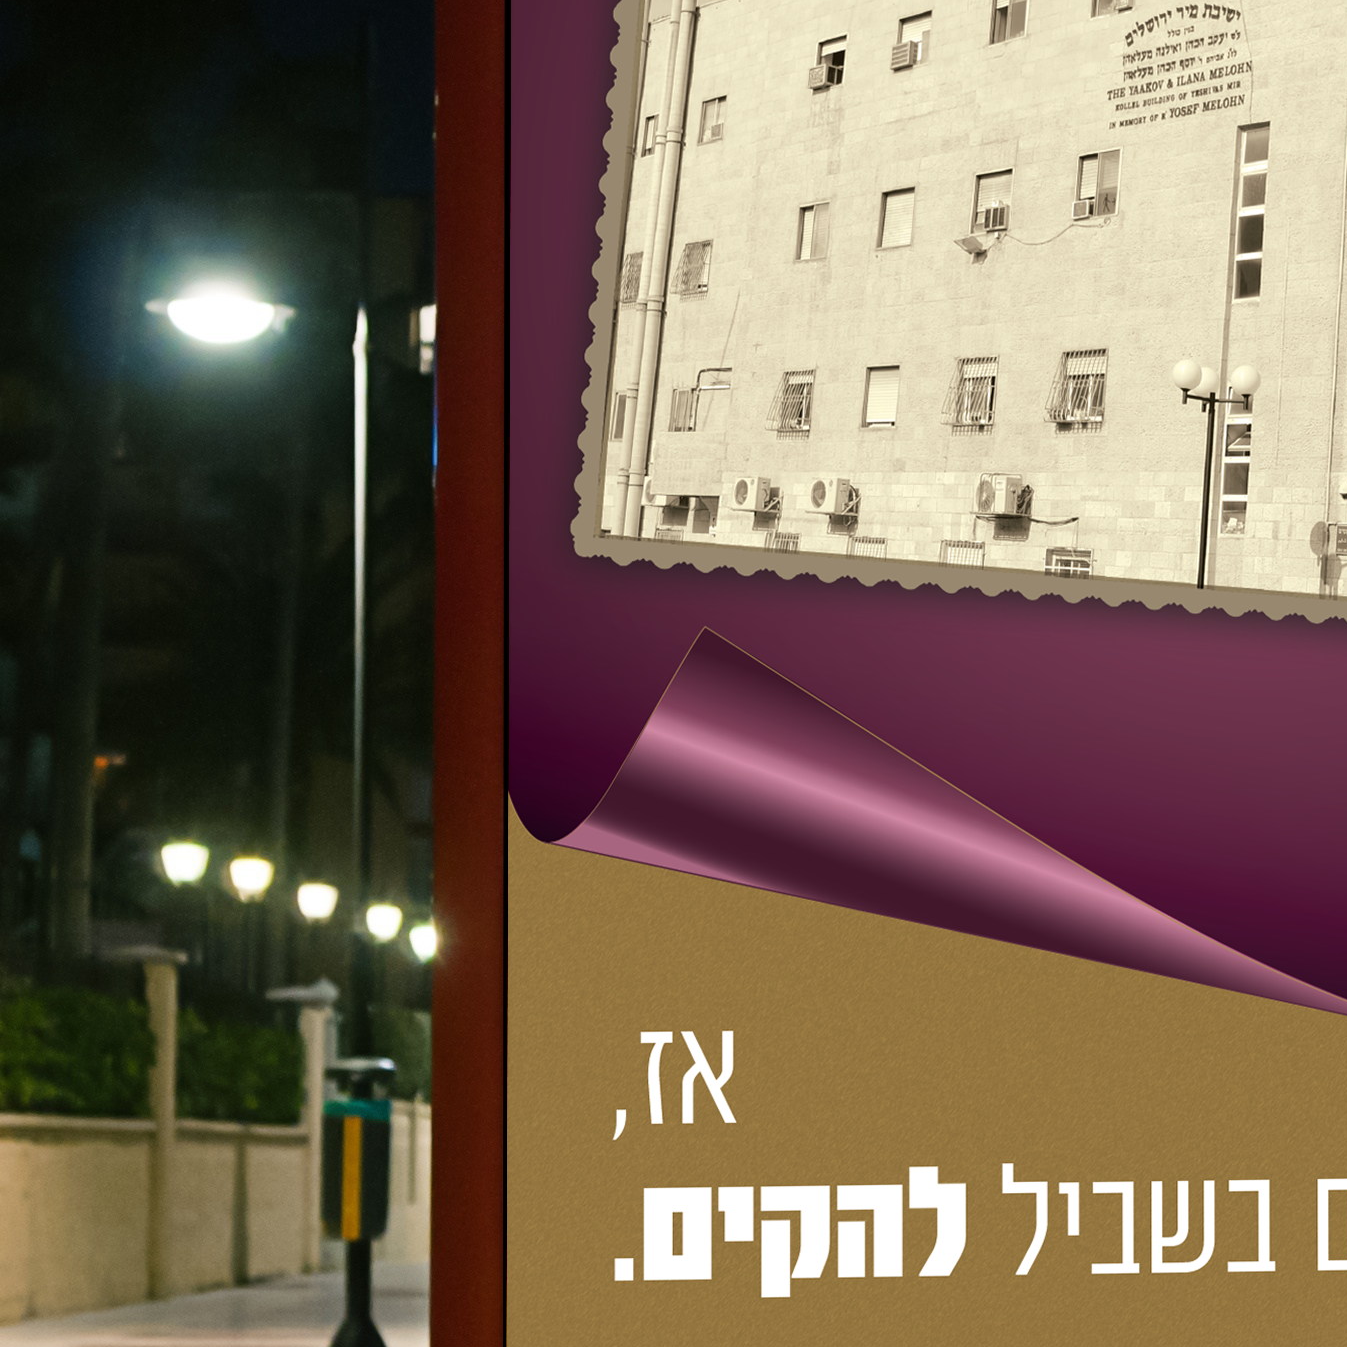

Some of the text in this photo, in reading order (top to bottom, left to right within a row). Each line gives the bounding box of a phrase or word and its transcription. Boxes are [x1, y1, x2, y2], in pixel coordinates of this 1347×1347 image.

[1125, 3, 1241, 47] ישיבת מיר ירושלים
[1107, 60, 1253, 101] THE YAAKOV & ILANA MELOHN
[1115, 101, 1140, 111] KOLLEL
[1142, 94, 1175, 107] BUILDING
[1178, 92, 1187, 101] OF
[1227, 80, 1241, 90] MIR
[1119, 116, 1147, 127] MEMORY
[1150, 113, 1159, 122] OF
[1169, 103, 1200, 118] YOSEF
[1202, 94, 1245, 112] MELOHN
[612, 1030, 737, 1141] אז,
[614, 1165, 967, 1299] להקים.
[1001, 1162, 1276, 1276] בשביל
